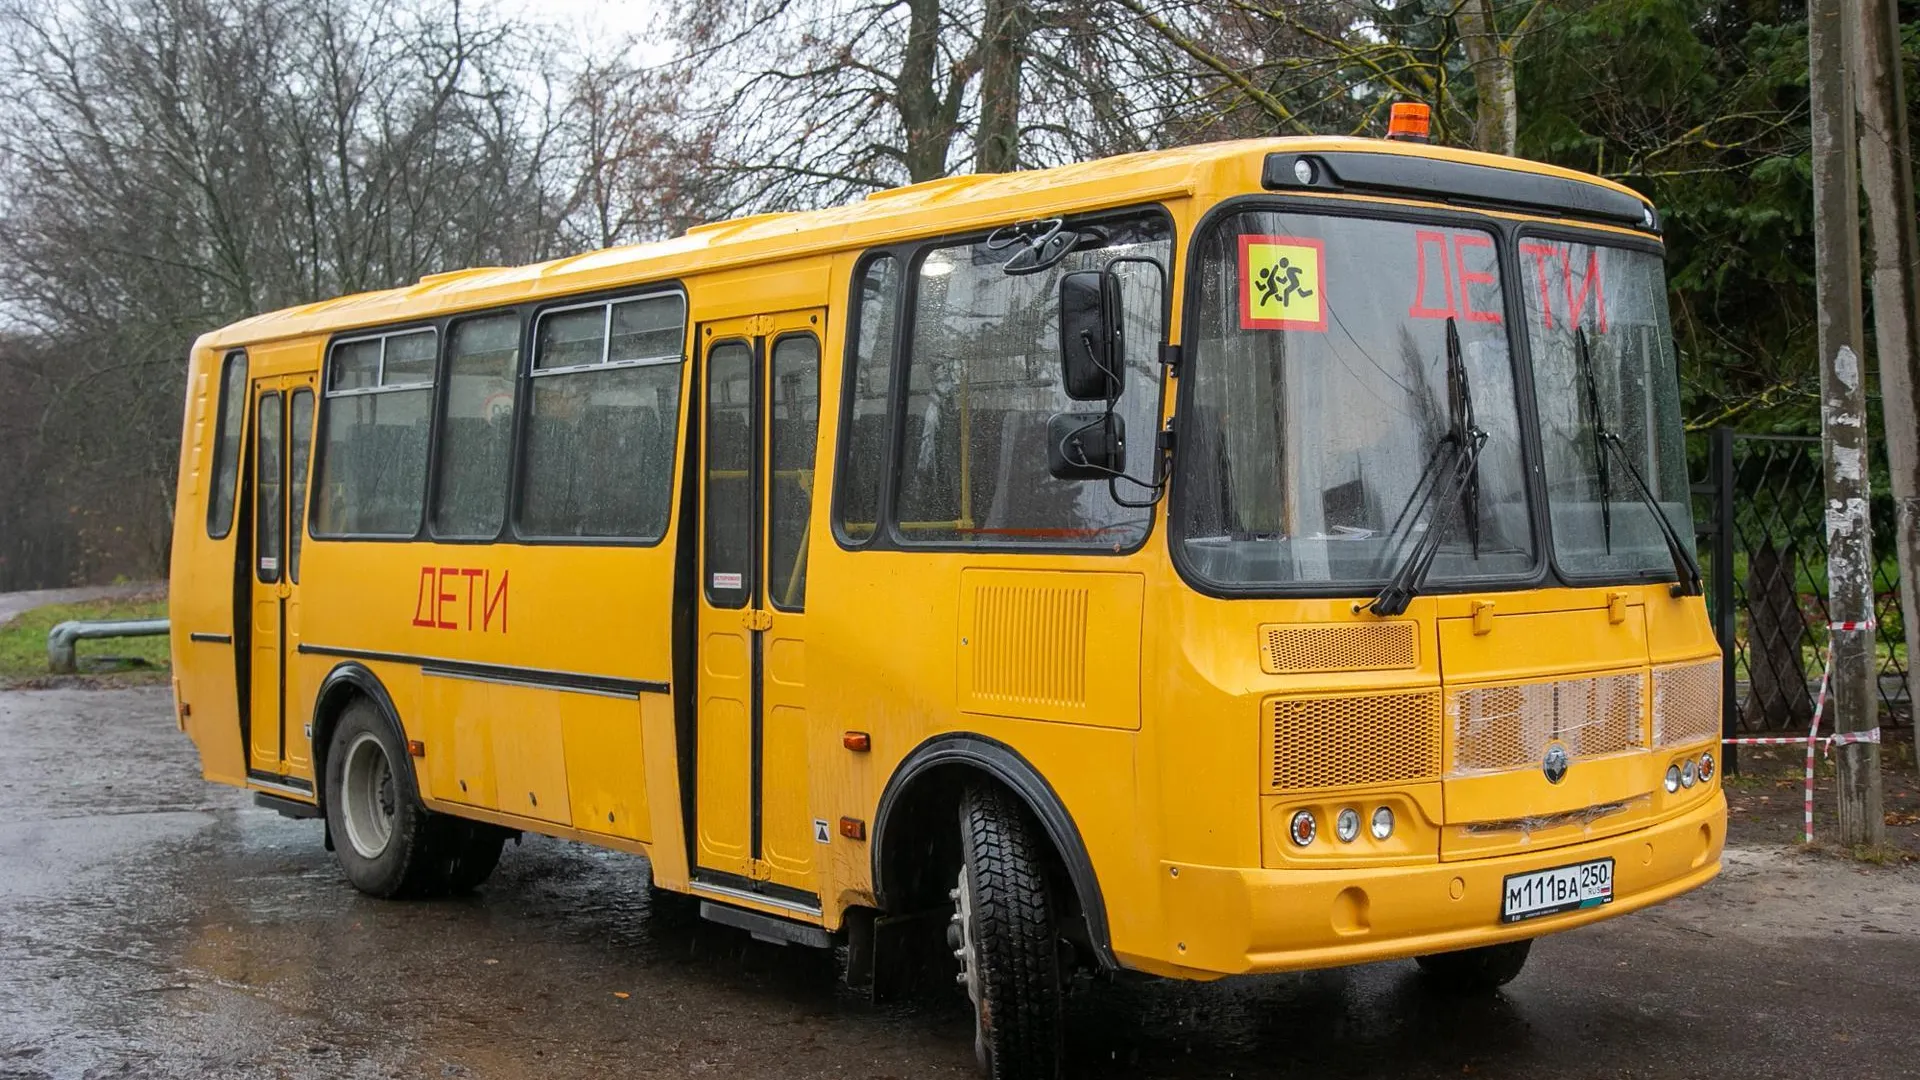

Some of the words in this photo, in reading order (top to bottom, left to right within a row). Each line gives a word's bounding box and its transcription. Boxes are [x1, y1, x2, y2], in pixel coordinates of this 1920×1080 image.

[1409, 230, 1608, 334] ДЕТИ
[412, 567, 508, 633] ДЕТИ
[1581, 863, 1607, 888] 250
